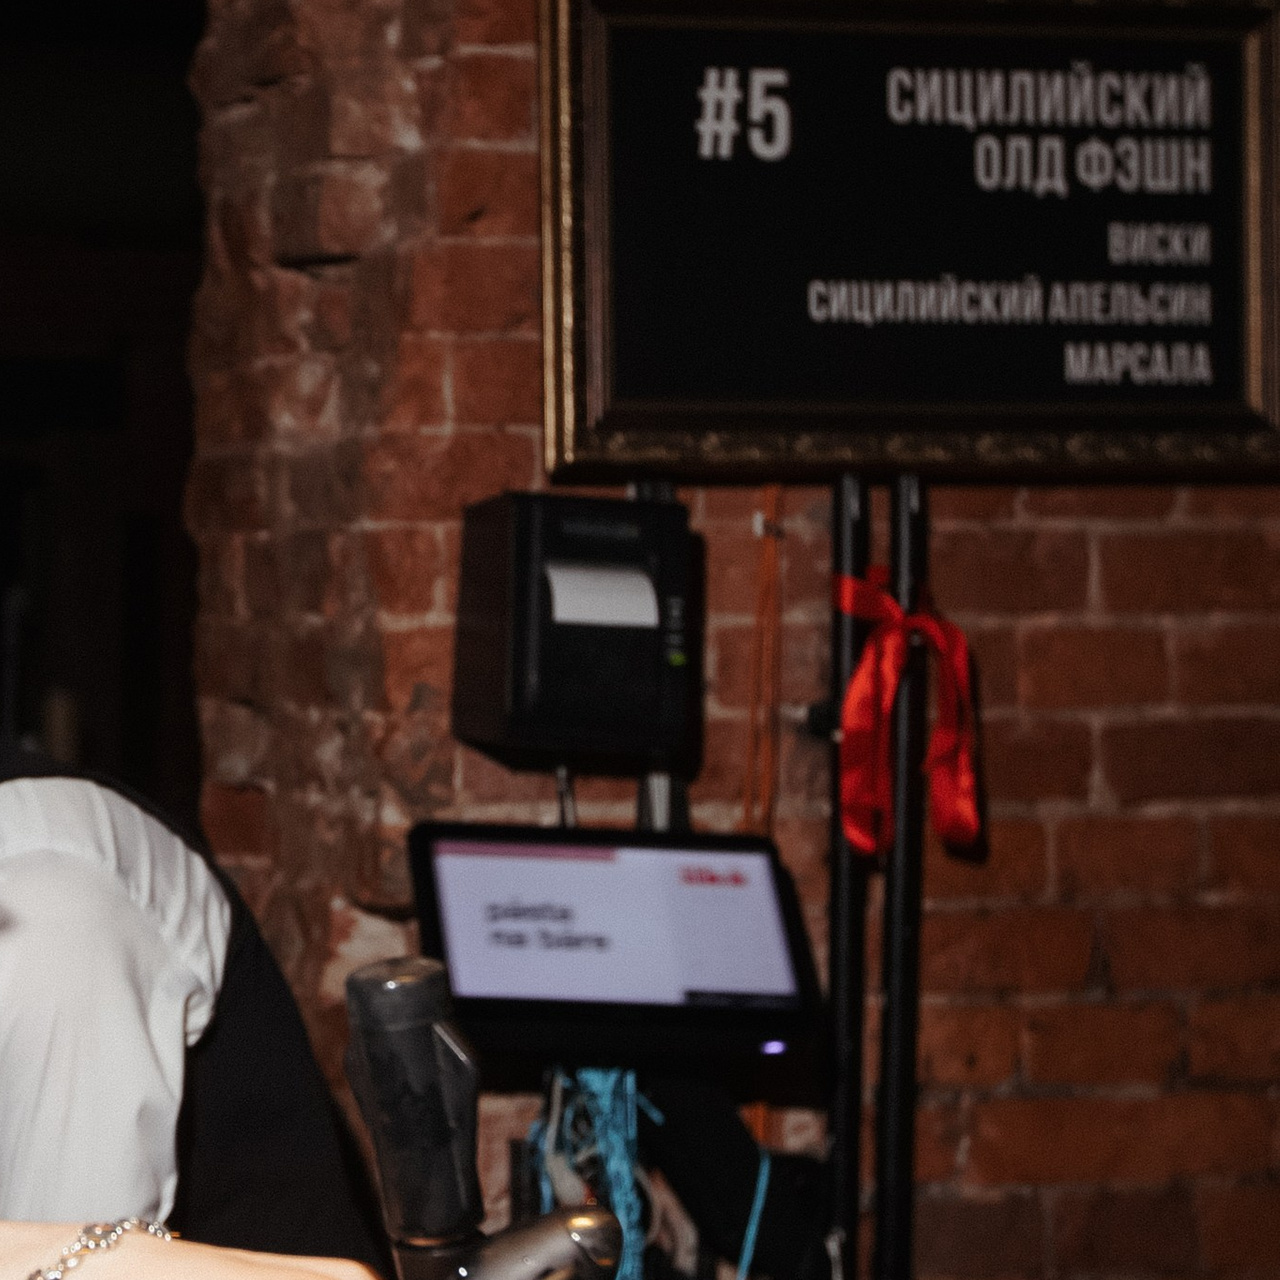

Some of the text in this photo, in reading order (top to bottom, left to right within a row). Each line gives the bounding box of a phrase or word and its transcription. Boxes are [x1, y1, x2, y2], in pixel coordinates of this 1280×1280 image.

[696, 68, 790, 160] #5
[886, 60, 1211, 132] СИЦИЛИЙСКИЙ
[975, 135, 1211, 196] ОЛД ФЭШН
[1108, 222, 1210, 264] ВИСКИ
[808, 275, 1211, 325] СИЦИЛИЙСКИЙ АПЕЛЬСИН
[1064, 342, 1212, 384] МАРСАЛА
